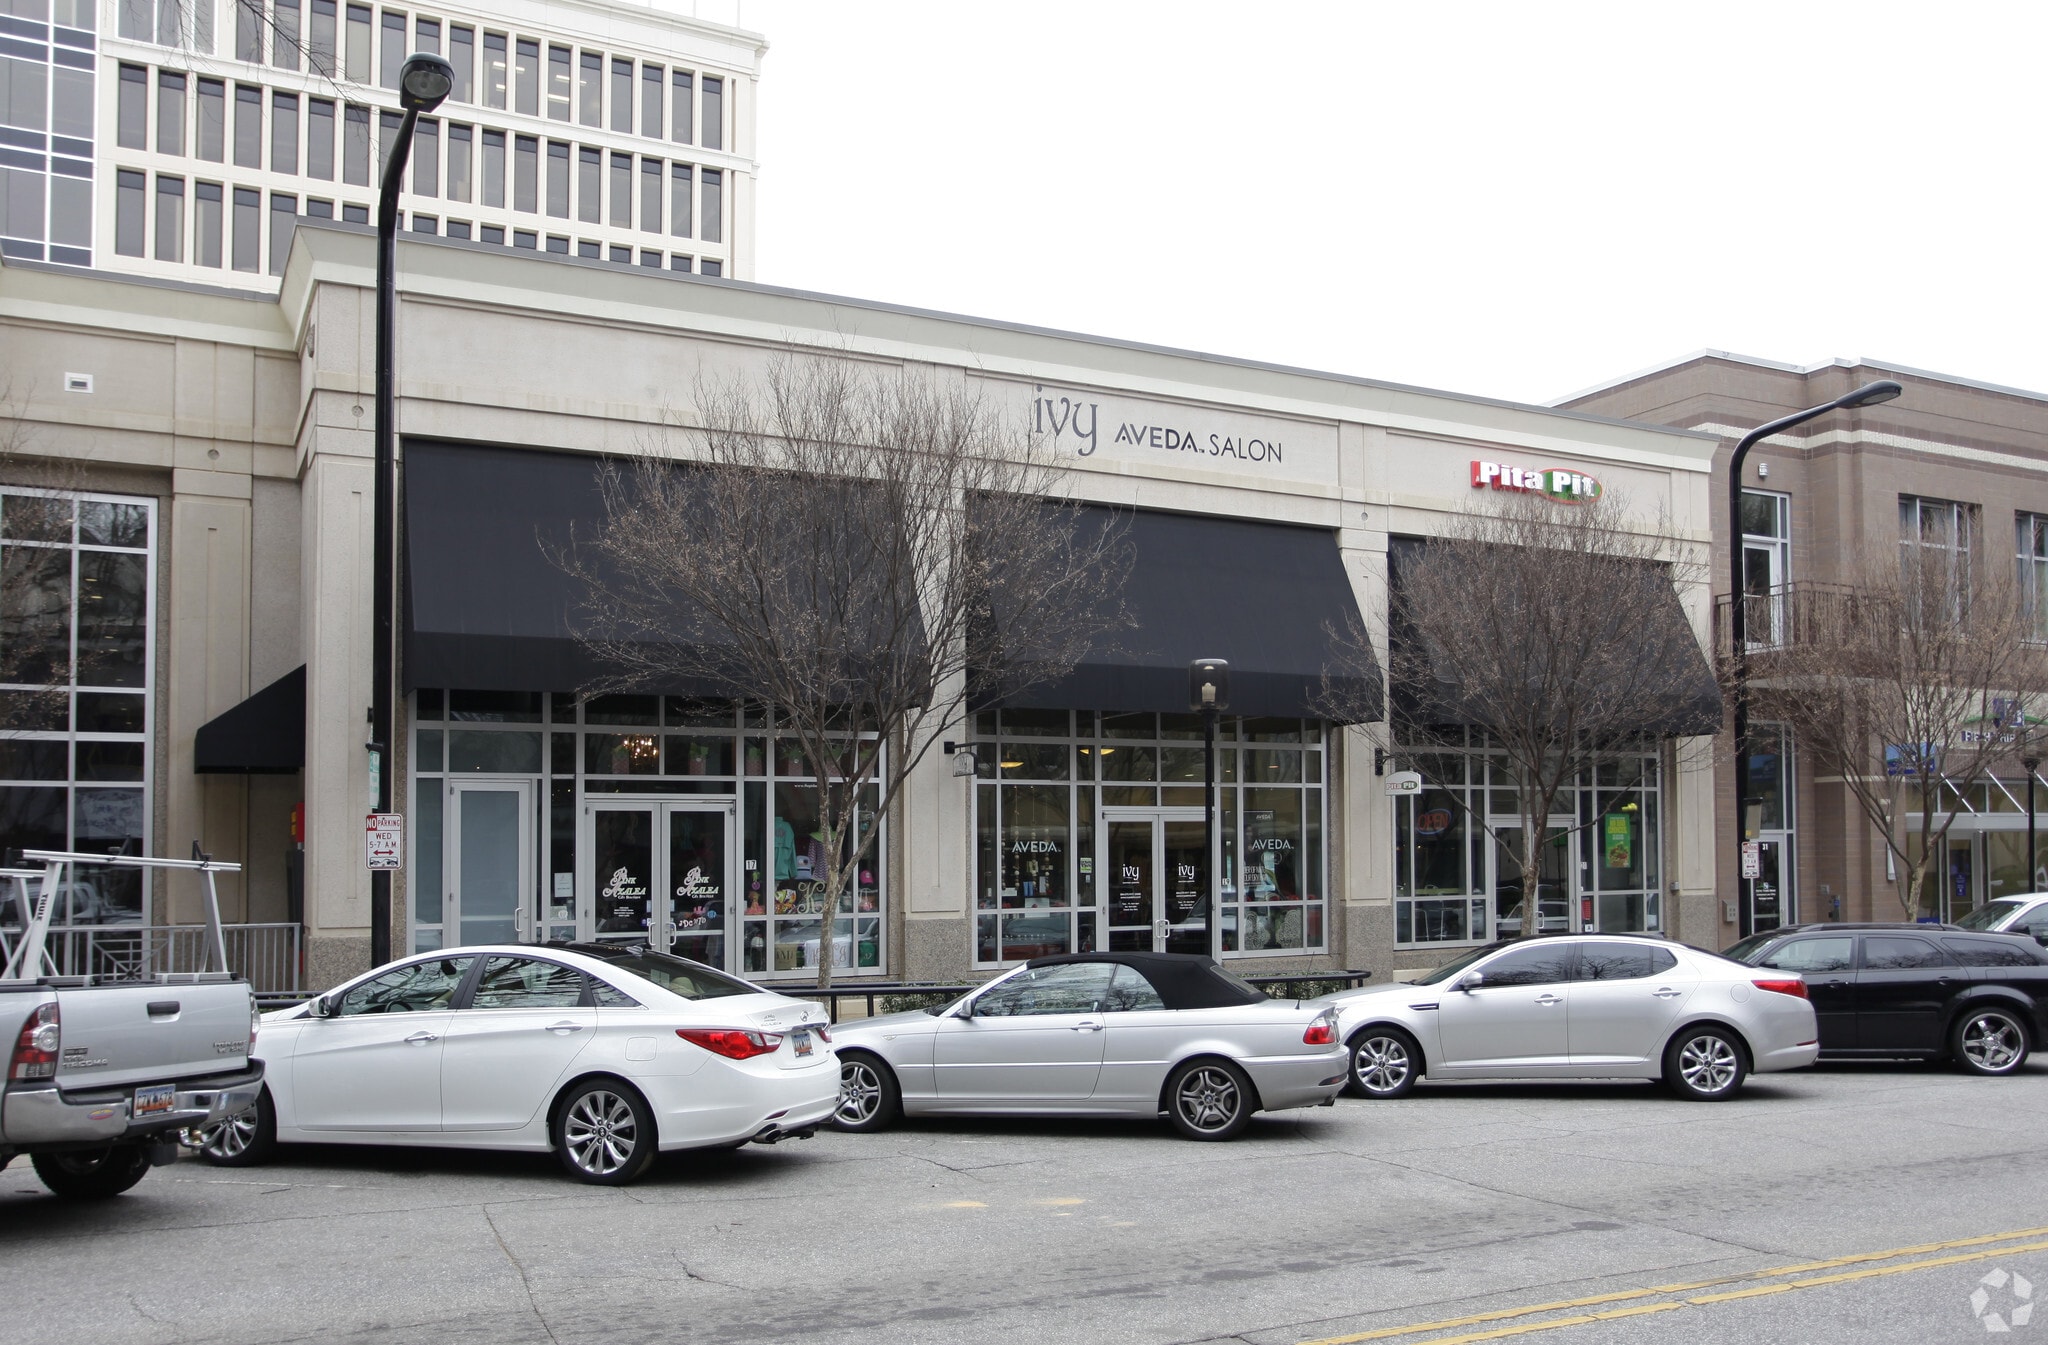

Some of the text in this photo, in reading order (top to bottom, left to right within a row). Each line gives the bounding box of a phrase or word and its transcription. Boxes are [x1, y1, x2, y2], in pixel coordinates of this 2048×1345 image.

[1035, 384, 1282, 463] ivy AVEDA SALON
[1473, 461, 1596, 497] Pita Pit
[366, 817, 401, 829] NO PARKING
[1418, 813, 1449, 831] OPEN
[375, 832, 392, 841] WED
[369, 841, 381, 849] 5-7
[1012, 841, 1058, 853] AVEDA
[1252, 839, 1291, 850] AVEDA
[1762, 843, 1769, 851] 31
[746, 861, 756, 870] 17
[1178, 863, 1195, 880] ivy
[1122, 863, 1140, 881] ivy
[37, 893, 49, 921] THULE
